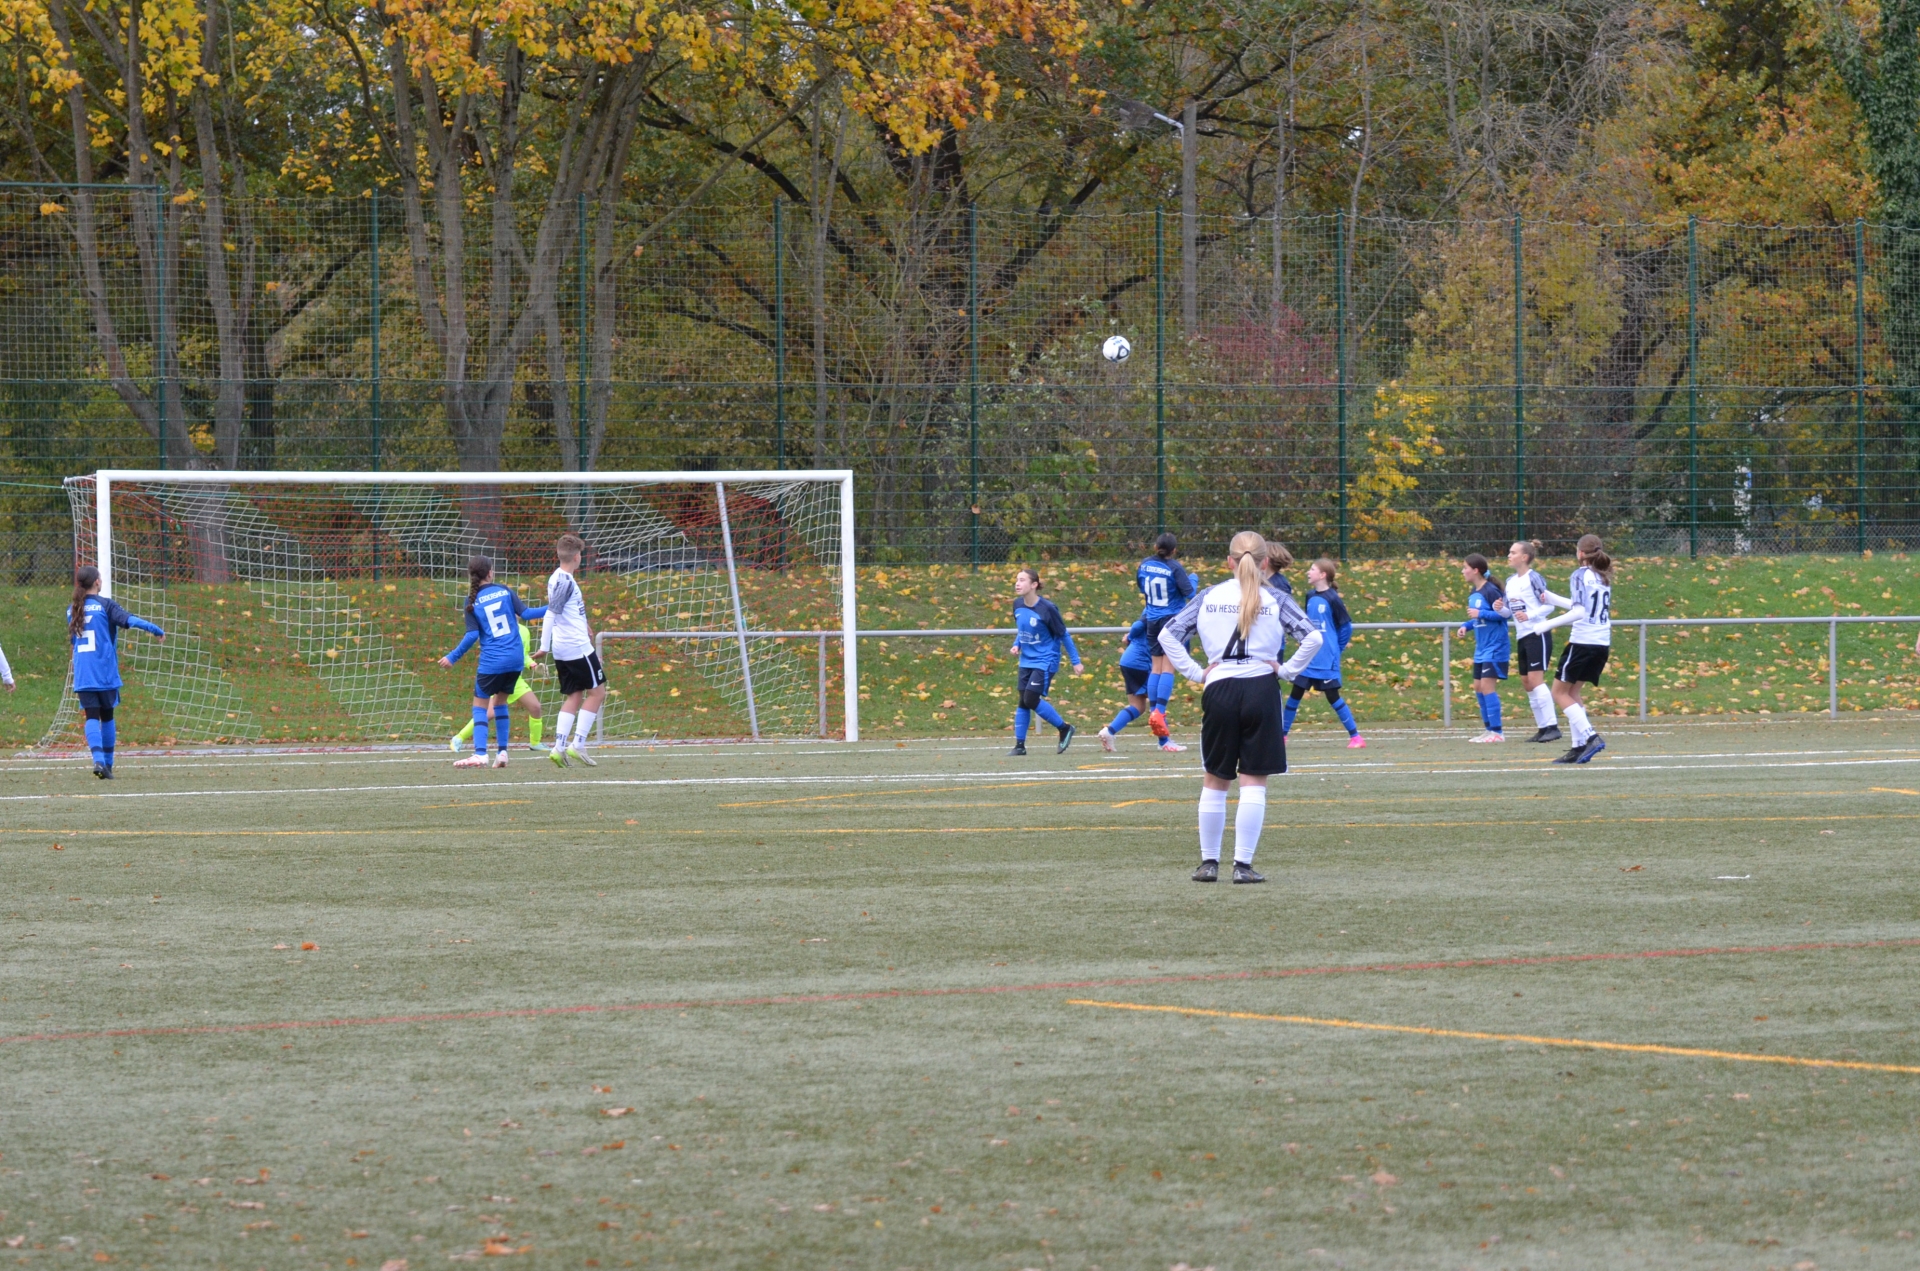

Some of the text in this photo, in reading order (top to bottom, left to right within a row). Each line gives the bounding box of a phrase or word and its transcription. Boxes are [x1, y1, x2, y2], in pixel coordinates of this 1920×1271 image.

[479, 590, 509, 604] EDDERSHEIM
[1144, 576, 1169, 607] 10
[1205, 604, 1218, 613] KSV
[1218, 604, 1241, 614] HESSE
[1589, 590, 1610, 625] 18
[77, 615, 96, 653] 5
[483, 601, 511, 638] 6
[1221, 622, 1253, 665] 4
